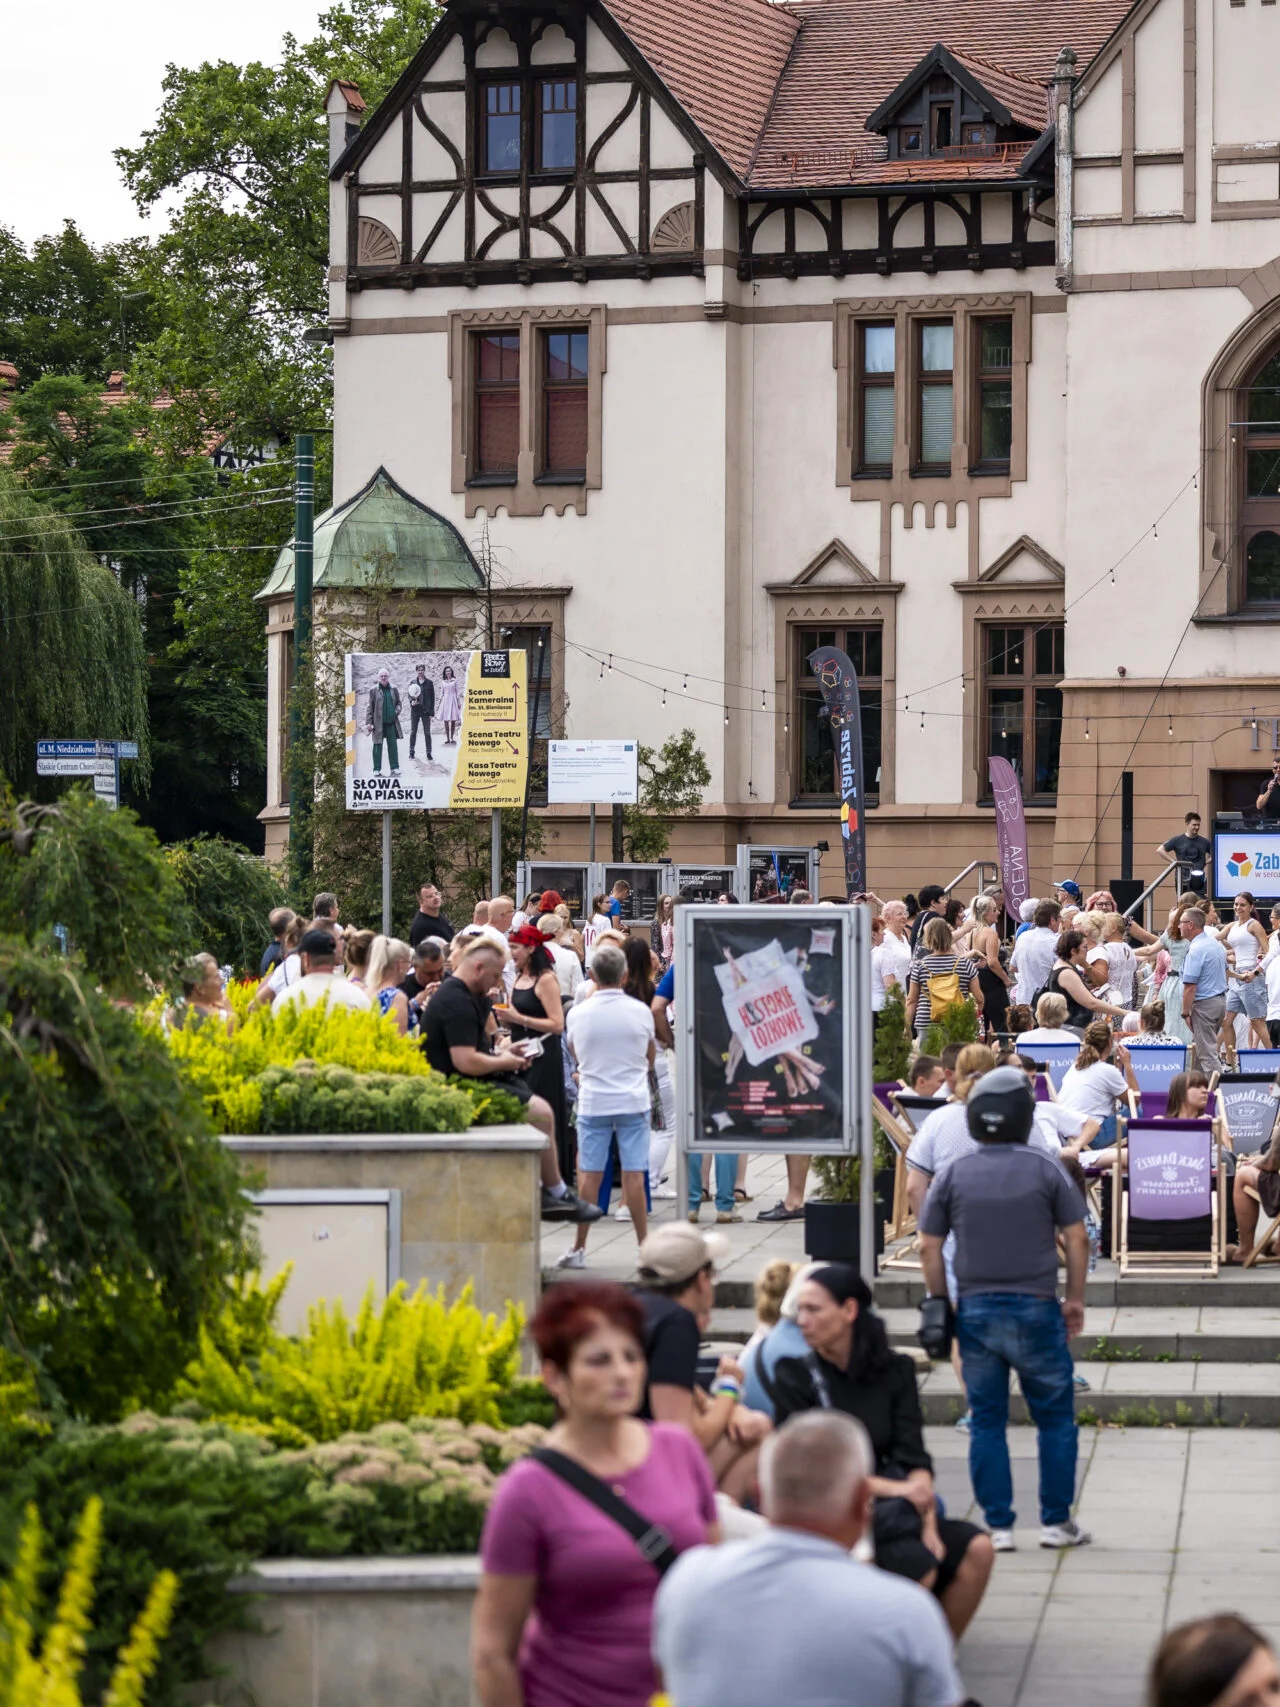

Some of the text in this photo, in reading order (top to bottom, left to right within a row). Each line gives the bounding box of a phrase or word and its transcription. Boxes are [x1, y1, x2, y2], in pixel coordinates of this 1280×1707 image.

[468, 696, 514, 704] Kameralna
[468, 740, 501, 748] Nowego
[468, 771, 501, 779] Nowego
[353, 779, 401, 790] SŁOWA
[353, 789, 424, 801] NA PIASKU
[452, 796, 521, 804] www.teatrzabrze.pl
